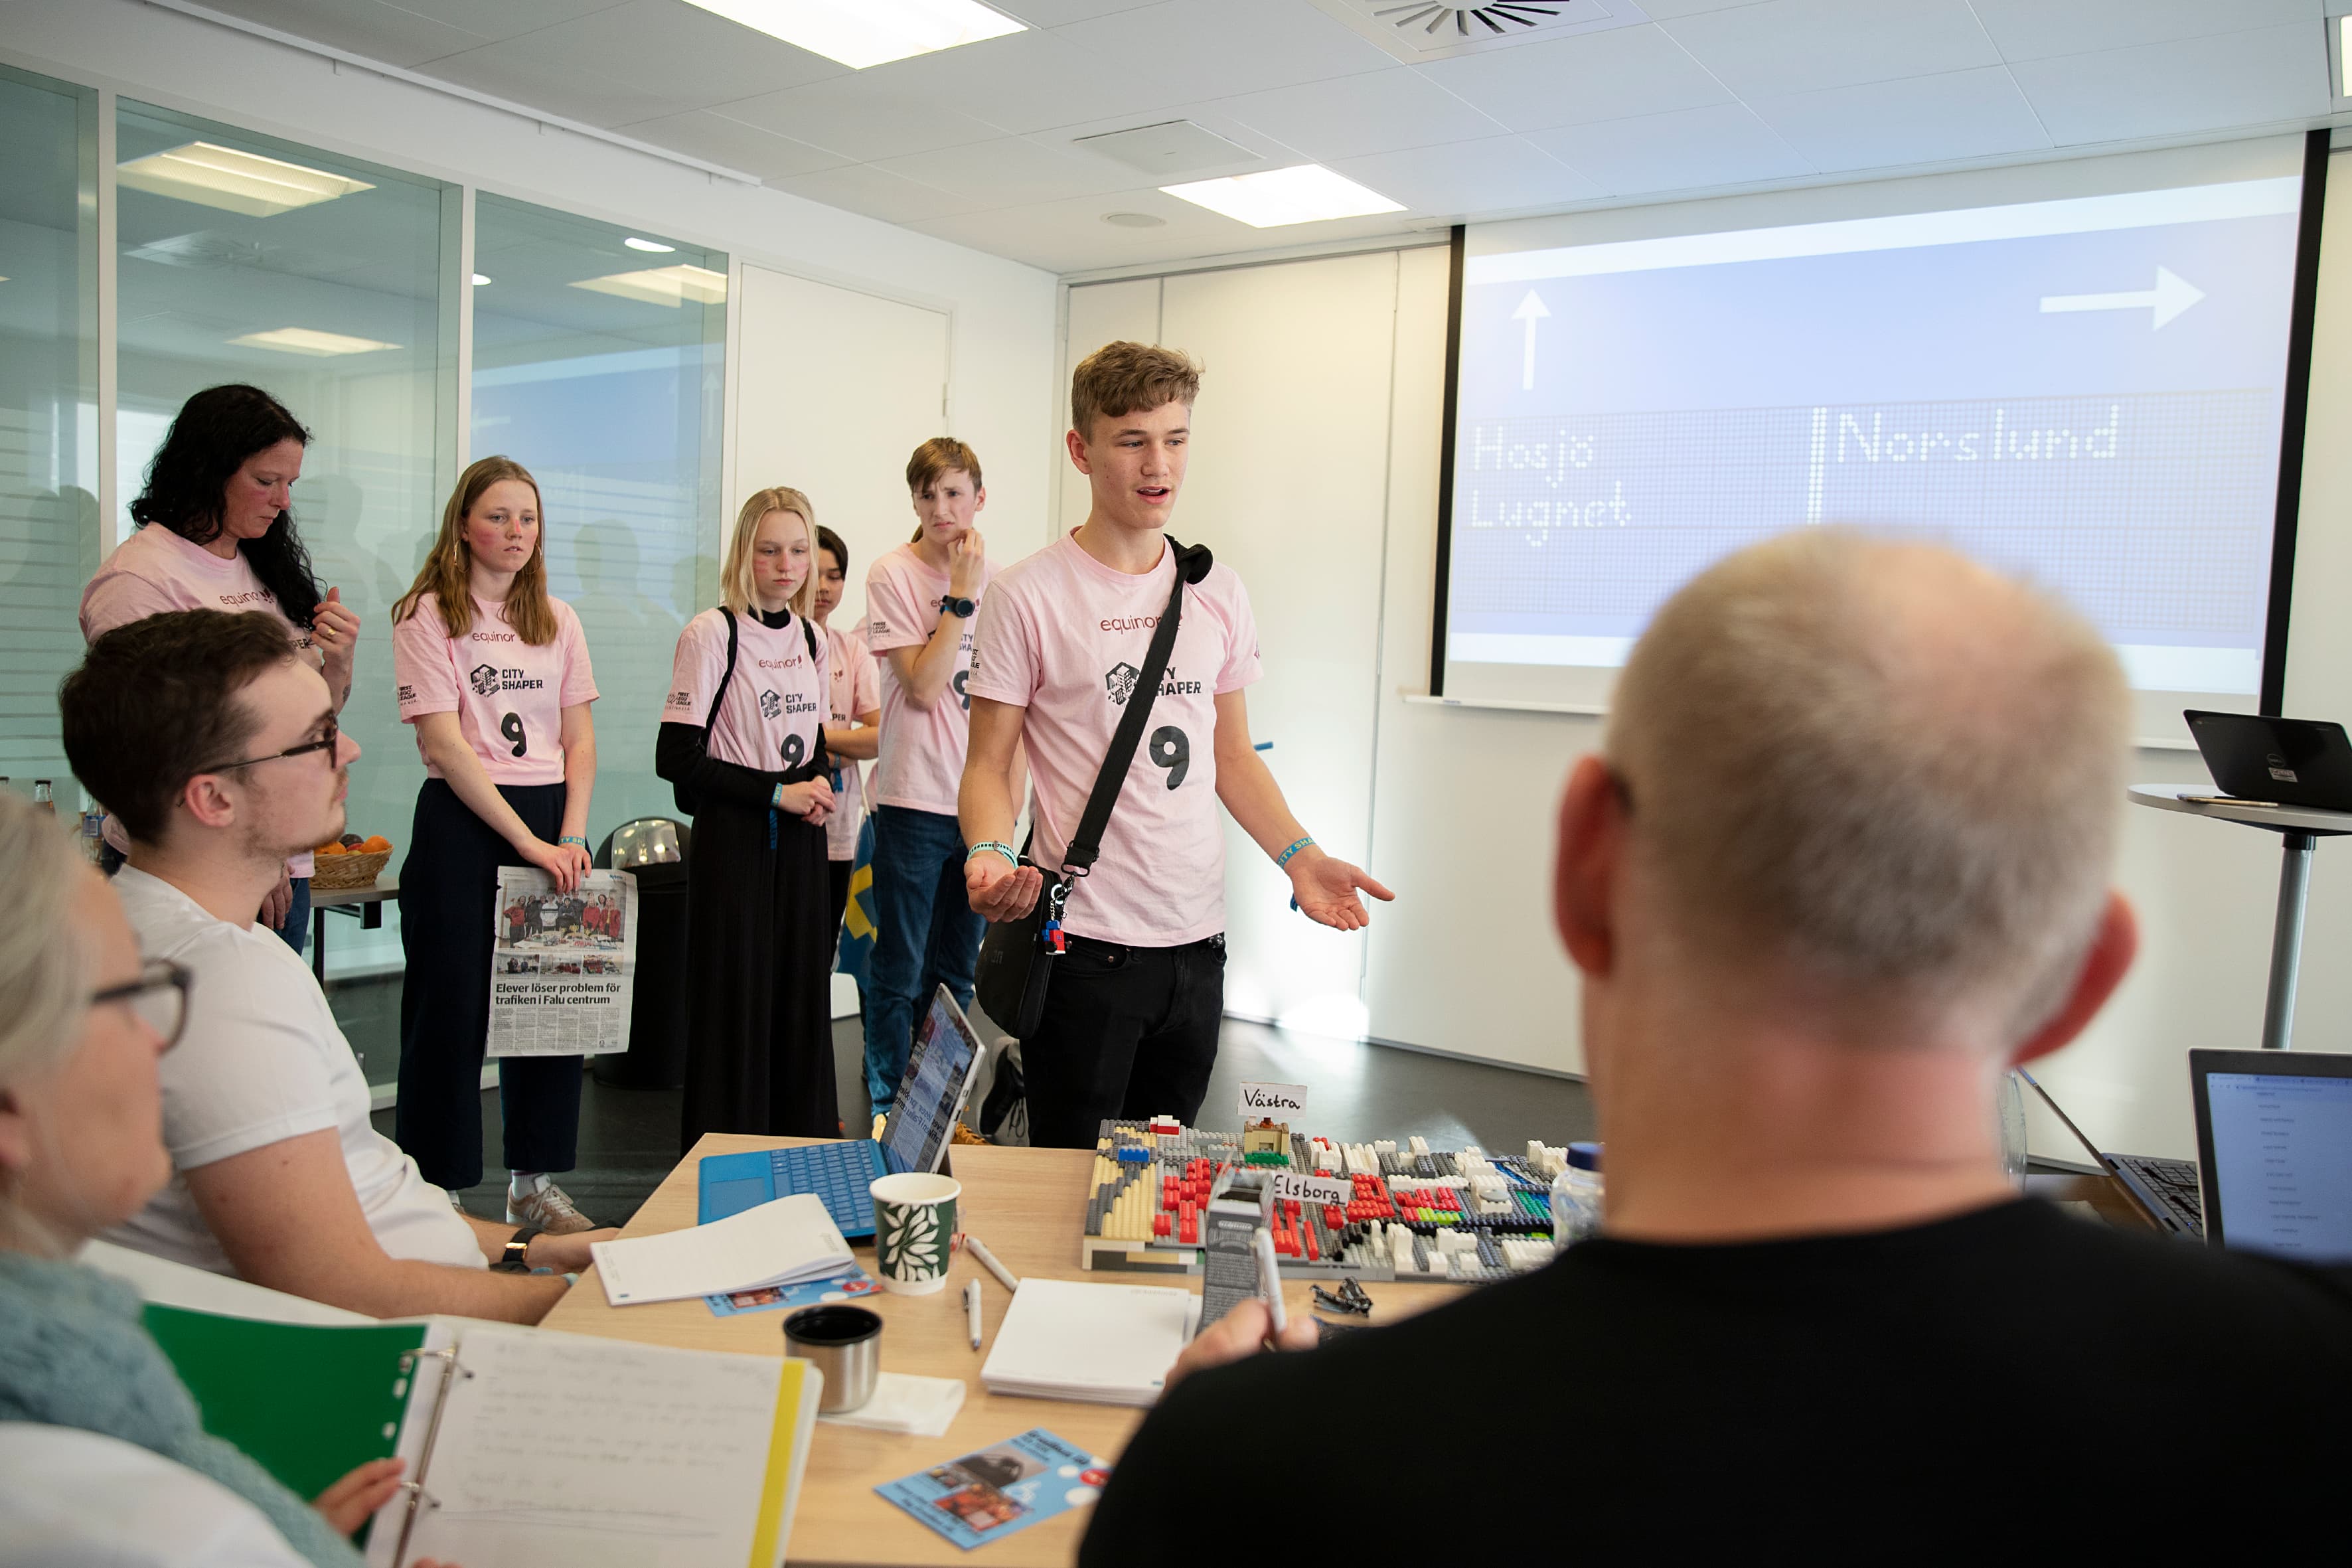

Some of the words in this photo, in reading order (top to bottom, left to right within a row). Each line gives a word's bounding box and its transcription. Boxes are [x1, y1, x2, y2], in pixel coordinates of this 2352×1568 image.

[1838, 404, 2120, 463] Norslund
[1474, 425, 1595, 489] Hosjö
[1472, 479, 1632, 547] Lugnet
[1100, 615, 1161, 635] equinor
[472, 631, 516, 643] equinor
[502, 669, 524, 678] CITY
[759, 658, 797, 670] equinor
[502, 679, 544, 690] SHAPER
[1156, 681, 1202, 696] HAPER
[832, 713, 846, 722] PER
[501, 712, 527, 757] 9
[781, 734, 805, 769] 9
[1149, 726, 1190, 791] 9
[496, 983, 529, 993] Elever
[532, 983, 558, 993] löser
[560, 983, 603, 994] problem
[606, 983, 621, 993] för
[496, 995, 536, 1005] trafiken
[538, 995, 542, 1004] i
[544, 995, 564, 1005] Falu
[567, 996, 610, 1004] centrum
[1244, 1088, 1300, 1110] Västra
[1275, 1174, 1346, 1205] Elsborg
